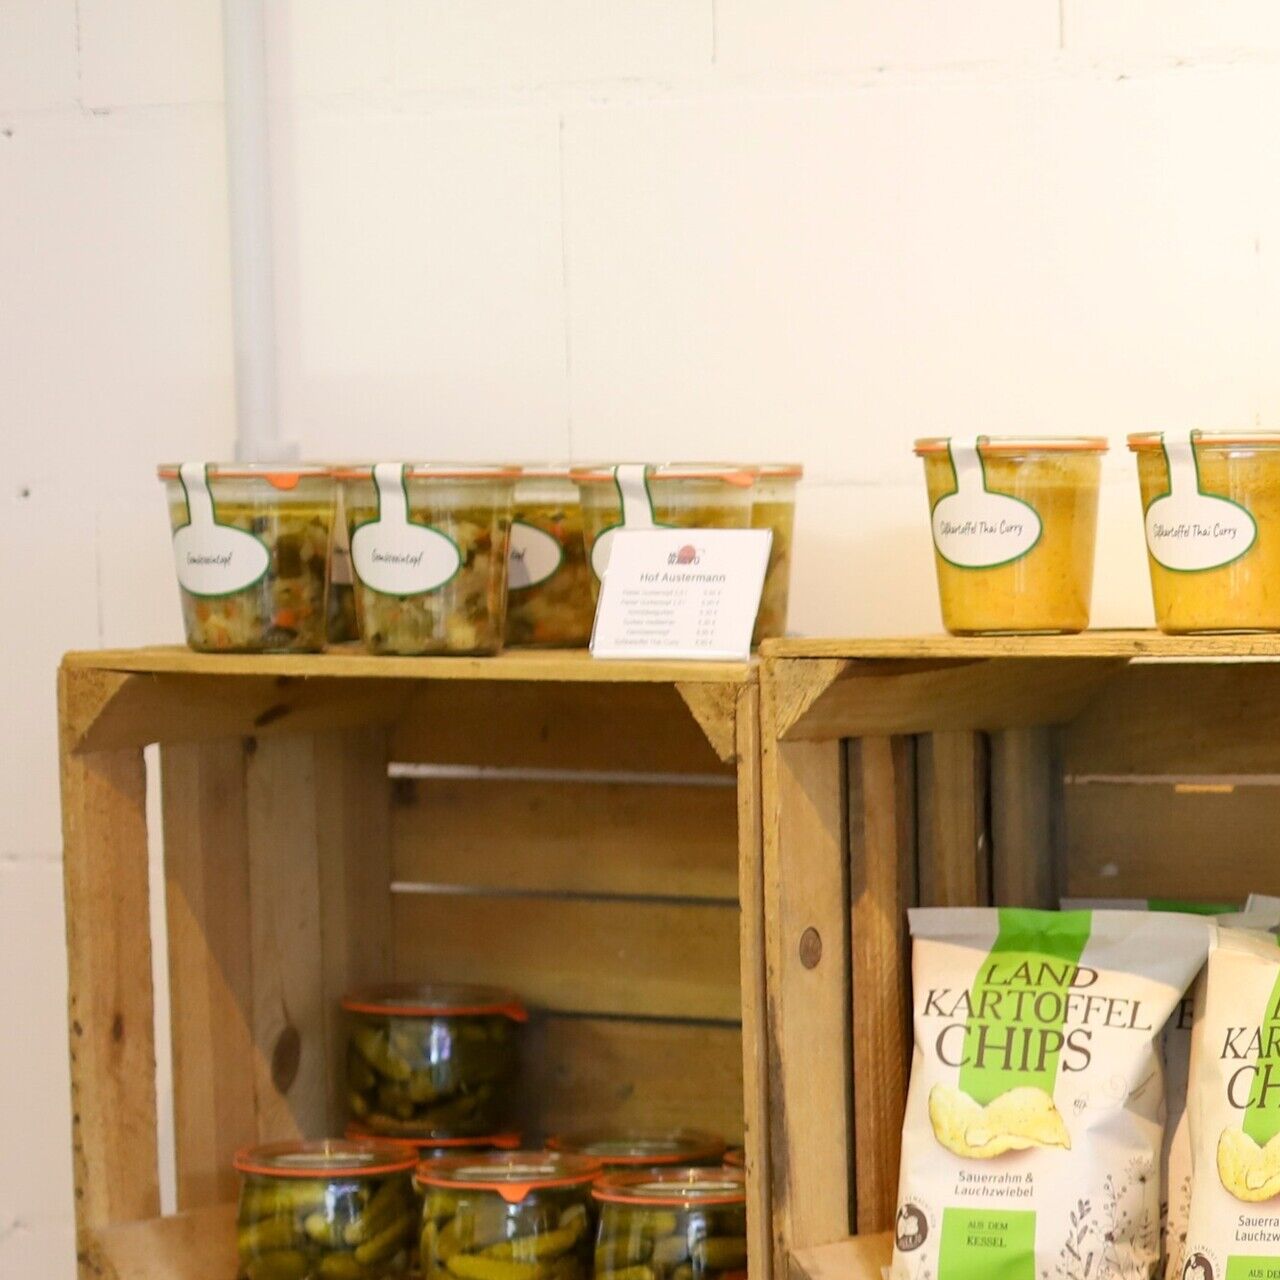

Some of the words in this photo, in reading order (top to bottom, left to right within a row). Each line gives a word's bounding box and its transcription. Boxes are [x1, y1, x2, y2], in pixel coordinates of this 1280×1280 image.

[979, 522, 996, 534] Thai
[1000, 520, 1023, 535] Curry
[1192, 524, 1210, 537] Thai
[1213, 524, 1237, 539] Curry
[640, 573, 658, 582] Hof
[662, 573, 726, 582] Austermann
[984, 960, 1099, 989] LAND
[922, 988, 1152, 1031] KARTOFFEL
[935, 1023, 1092, 1073] CHIPS
[959, 1170, 1022, 1183] Sauerrahm
[1025, 1173, 1033, 1183] &
[955, 1185, 1033, 1197] Lauchzwiebel
[987, 1221, 1008, 1230] DEM
[966, 1236, 1007, 1248] KESSEL
[1248, 1270, 1264, 1278] AUS
